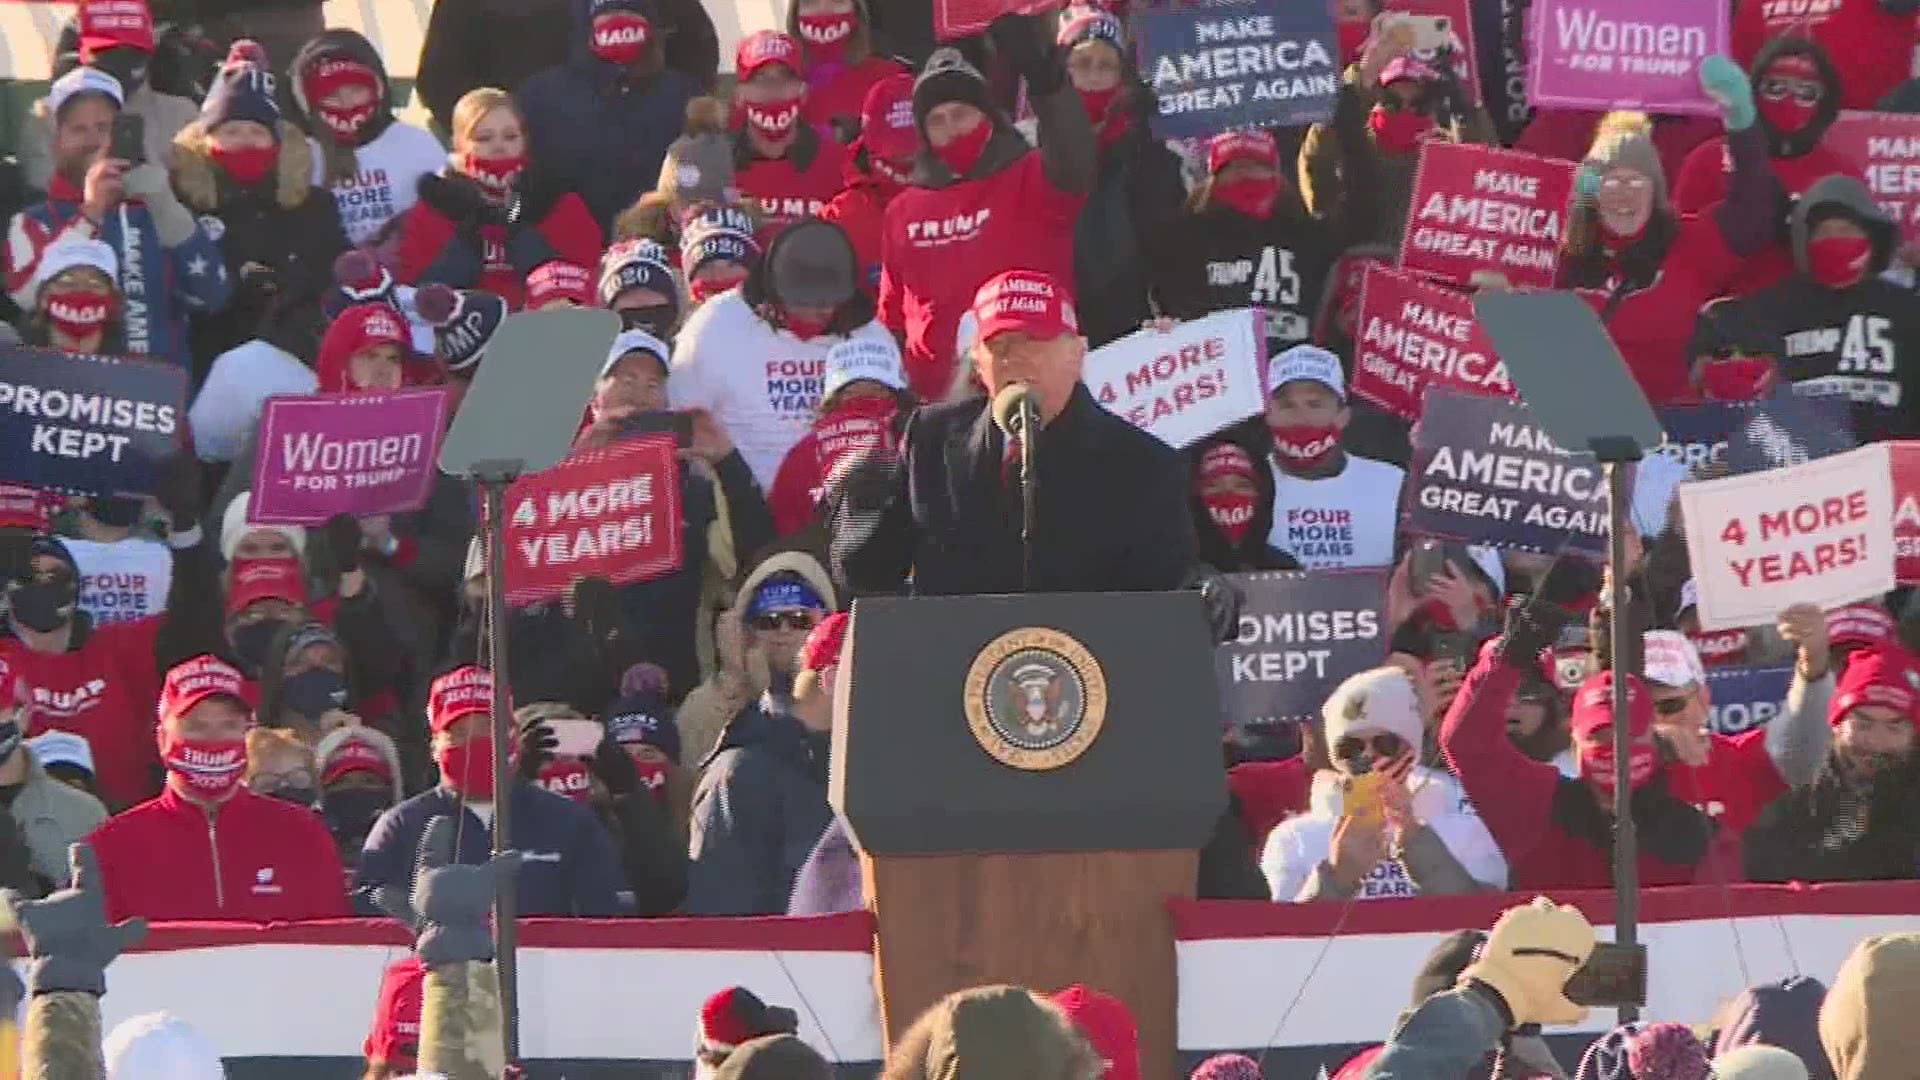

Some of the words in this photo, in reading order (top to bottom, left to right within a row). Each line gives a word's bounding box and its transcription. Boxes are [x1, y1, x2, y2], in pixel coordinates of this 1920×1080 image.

[1196, 15, 1274, 43] MAKE
[1557, 7, 1706, 57] Women
[1153, 40, 1332, 88] AMERICA
[1568, 54, 1613, 70] FOR
[1621, 55, 1692, 76] TRUMP
[1157, 83, 1245, 114] GREAT
[1253, 73, 1337, 101] AGAIN
[1474, 169, 1540, 198] MAKE
[907, 208, 990, 240] TRUMP
[1420, 192, 1559, 241] AMERICA
[1414, 228, 1499, 259] GREAT
[1500, 246, 1554, 271] AGAIN
[1206, 257, 1252, 286] TRUMP
[1251, 246, 1299, 304] 45
[51, 301, 106, 323] MAGA
[1401, 302, 1472, 342] MAKE
[1363, 317, 1512, 391] AMERICA
[1785, 328, 1841, 357] TRUMP
[1837, 315, 1896, 374] 45
[1099, 382, 1118, 403] 4
[1125, 336, 1226, 396] MORE
[1363, 351, 1418, 392] GREAT
[1127, 368, 1229, 429] EARS!
[31, 424, 130, 463] KEPT
[283, 432, 422, 472] Women
[1274, 434, 1336, 457] MAGA
[1490, 421, 1569, 453] MAK
[294, 475, 337, 491] FOR
[344, 468, 406, 489] TRUMP
[512, 497, 537, 529] 4
[547, 473, 654, 527] MORE
[1287, 508, 1353, 524] FOUR
[1420, 486, 1519, 520] GREAT
[1721, 518, 1747, 545] 4
[1759, 489, 1868, 541] MORE
[517, 512, 653, 567] YEARS!
[1288, 526, 1354, 541] MORE
[1290, 542, 1354, 557] YEARS
[1730, 533, 1868, 588] YEARS!
[80, 574, 146, 591] FOUR
[81, 592, 148, 609] MORE
[1237, 609, 1379, 645] OMISES
[1232, 650, 1332, 683] KEPT
